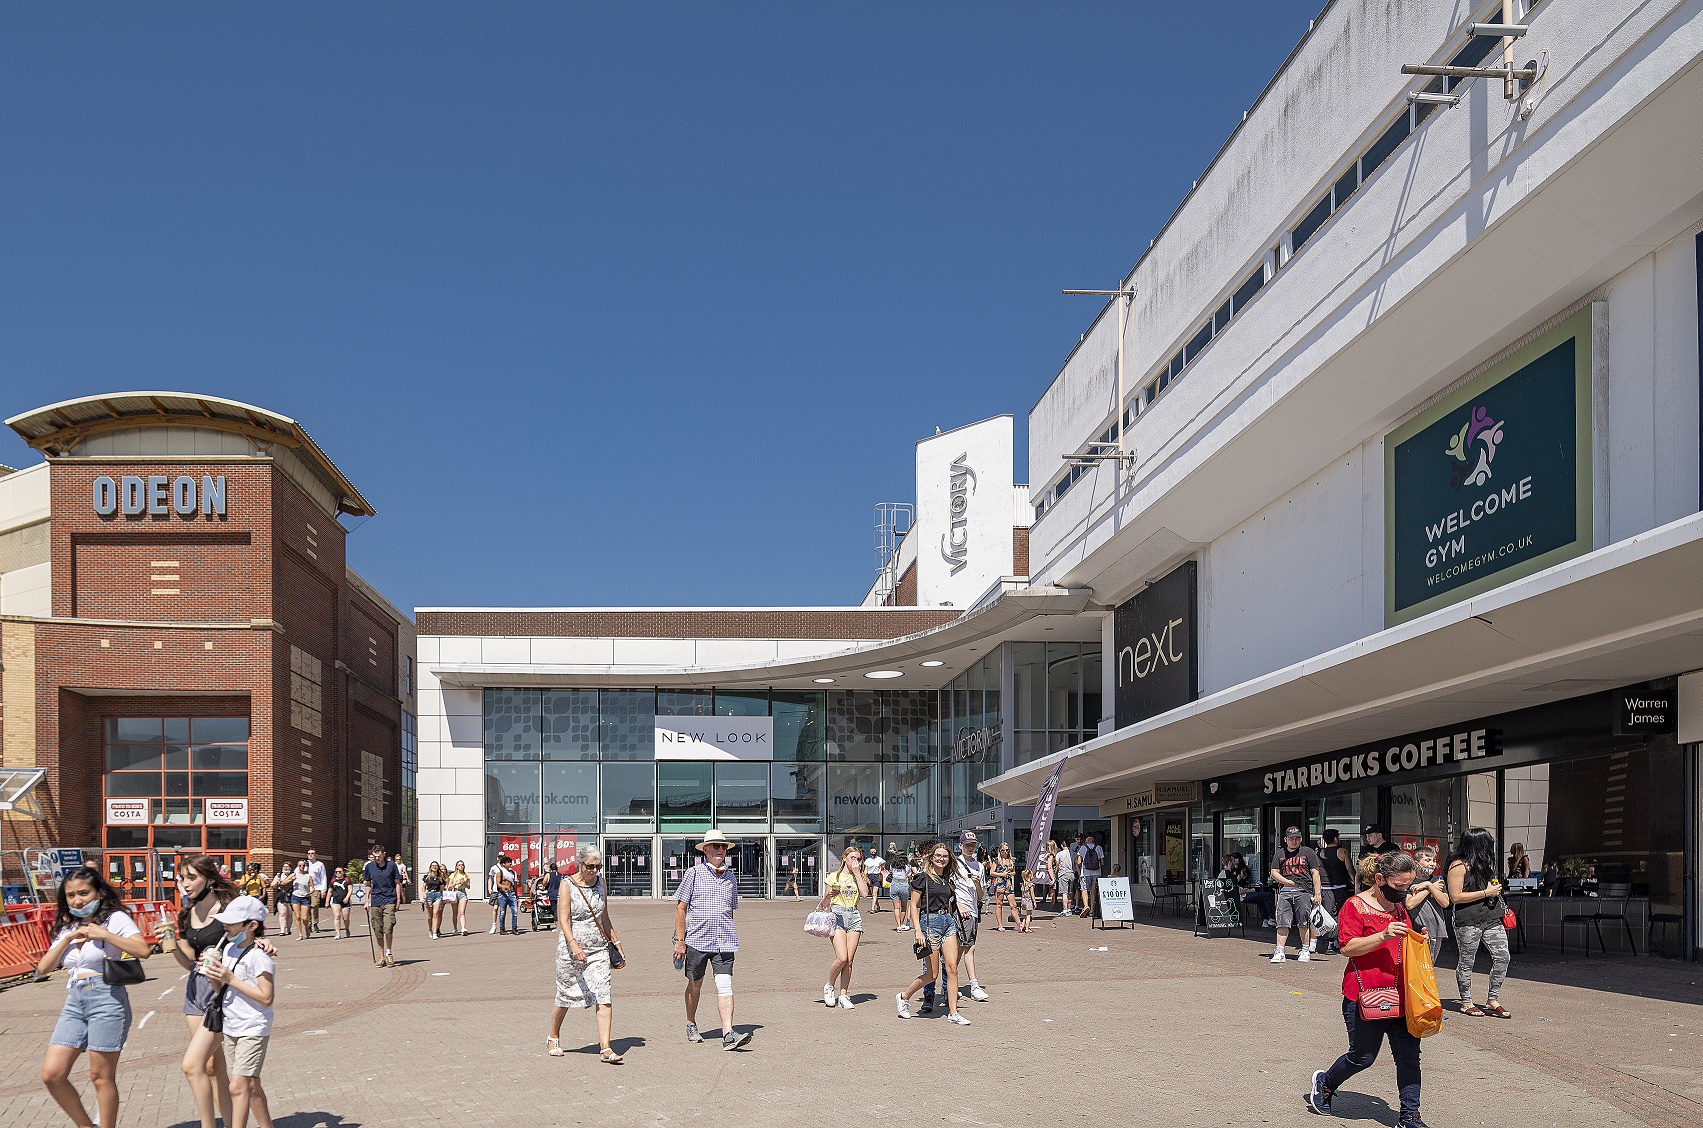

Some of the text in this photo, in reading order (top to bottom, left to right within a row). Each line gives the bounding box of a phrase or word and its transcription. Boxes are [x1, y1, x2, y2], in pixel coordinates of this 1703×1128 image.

[93, 474, 226, 515] ODEON
[941, 451, 977, 577] VICTORY
[1425, 475, 1532, 543] WELCOME
[1425, 535, 1465, 568] GYM
[1426, 534, 1533, 587] WELCOMEGYM.CO.UK
[1119, 617, 1183, 688] next
[1625, 697, 1668, 710] Warren
[1628, 712, 1665, 726] James
[661, 732, 767, 743] NEW LOOK
[1263, 728, 1487, 795] STARBUCKS COFFEE
[834, 793, 916, 805] newloo.com
[1126, 793, 1160, 810] H.SAMU
[529, 856, 549, 868] SAE
[556, 855, 576, 868] SALE
[1280, 856, 1307, 866] TRUE
[1102, 890, 1127, 898] £10 OFF
